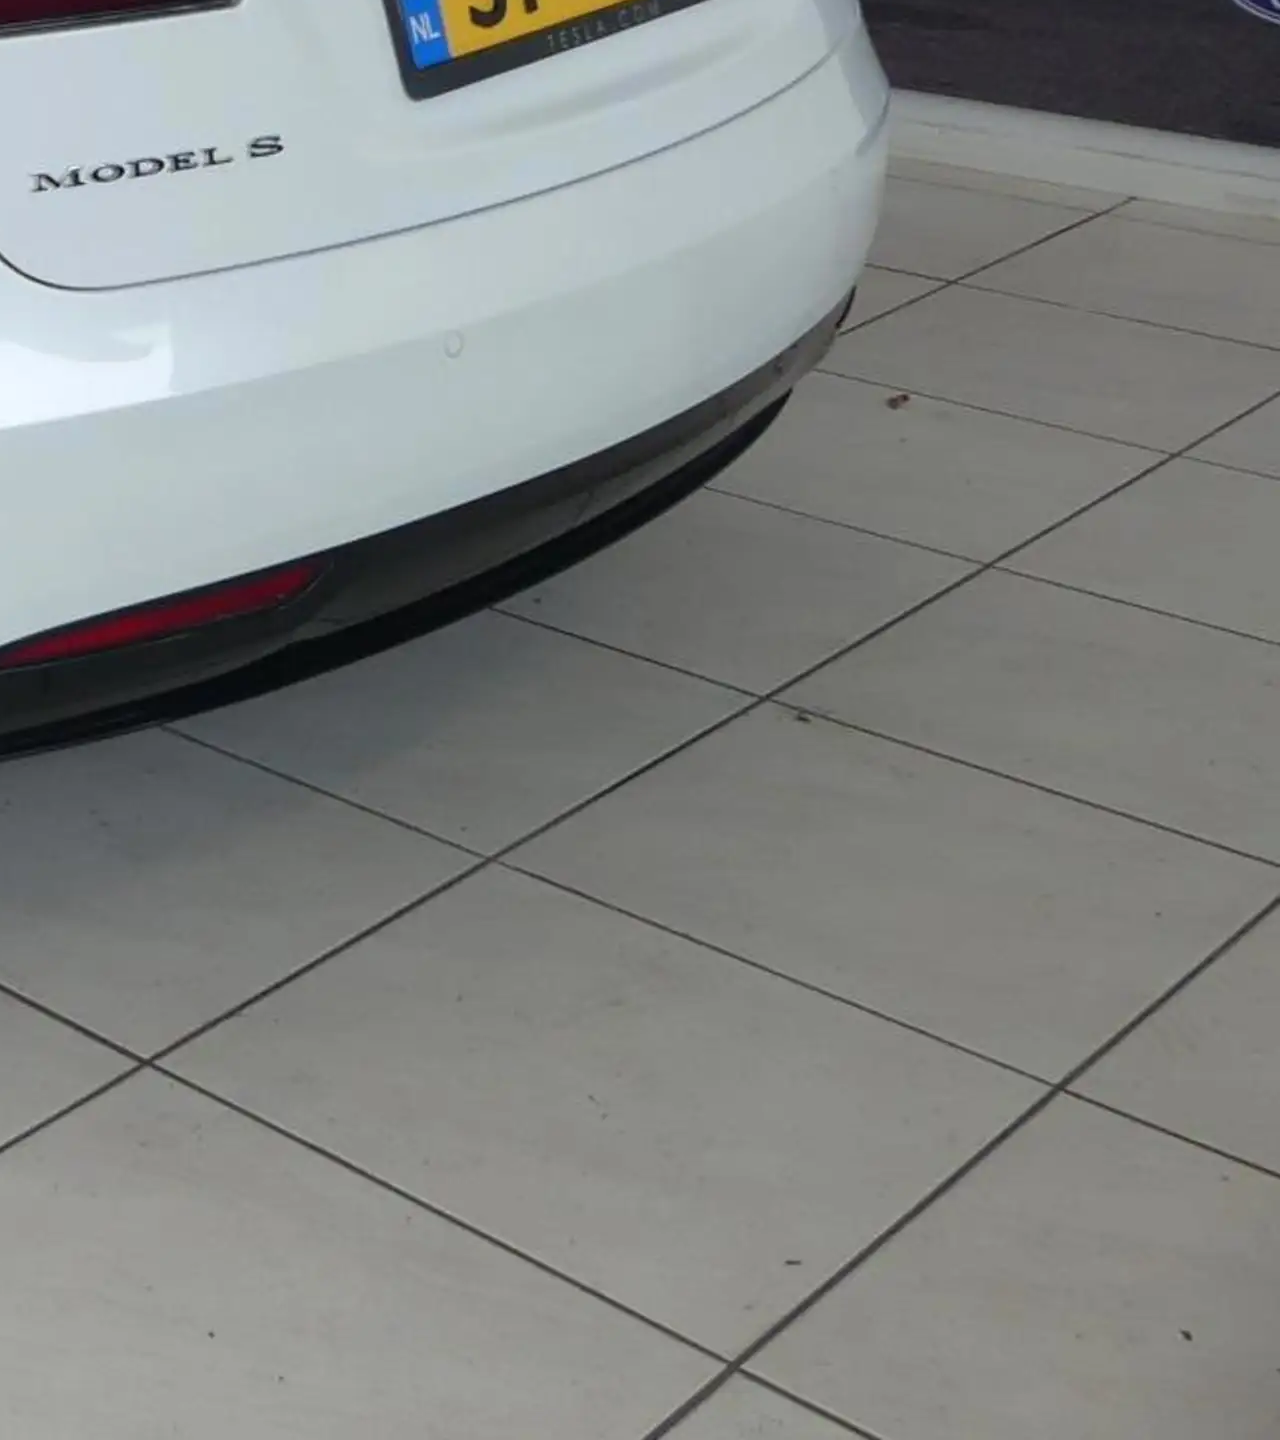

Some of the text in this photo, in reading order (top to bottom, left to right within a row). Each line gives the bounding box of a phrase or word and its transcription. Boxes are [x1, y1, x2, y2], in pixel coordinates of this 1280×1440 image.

[409, 15, 442, 44] NL
[30, 135, 285, 193] MODEL S
